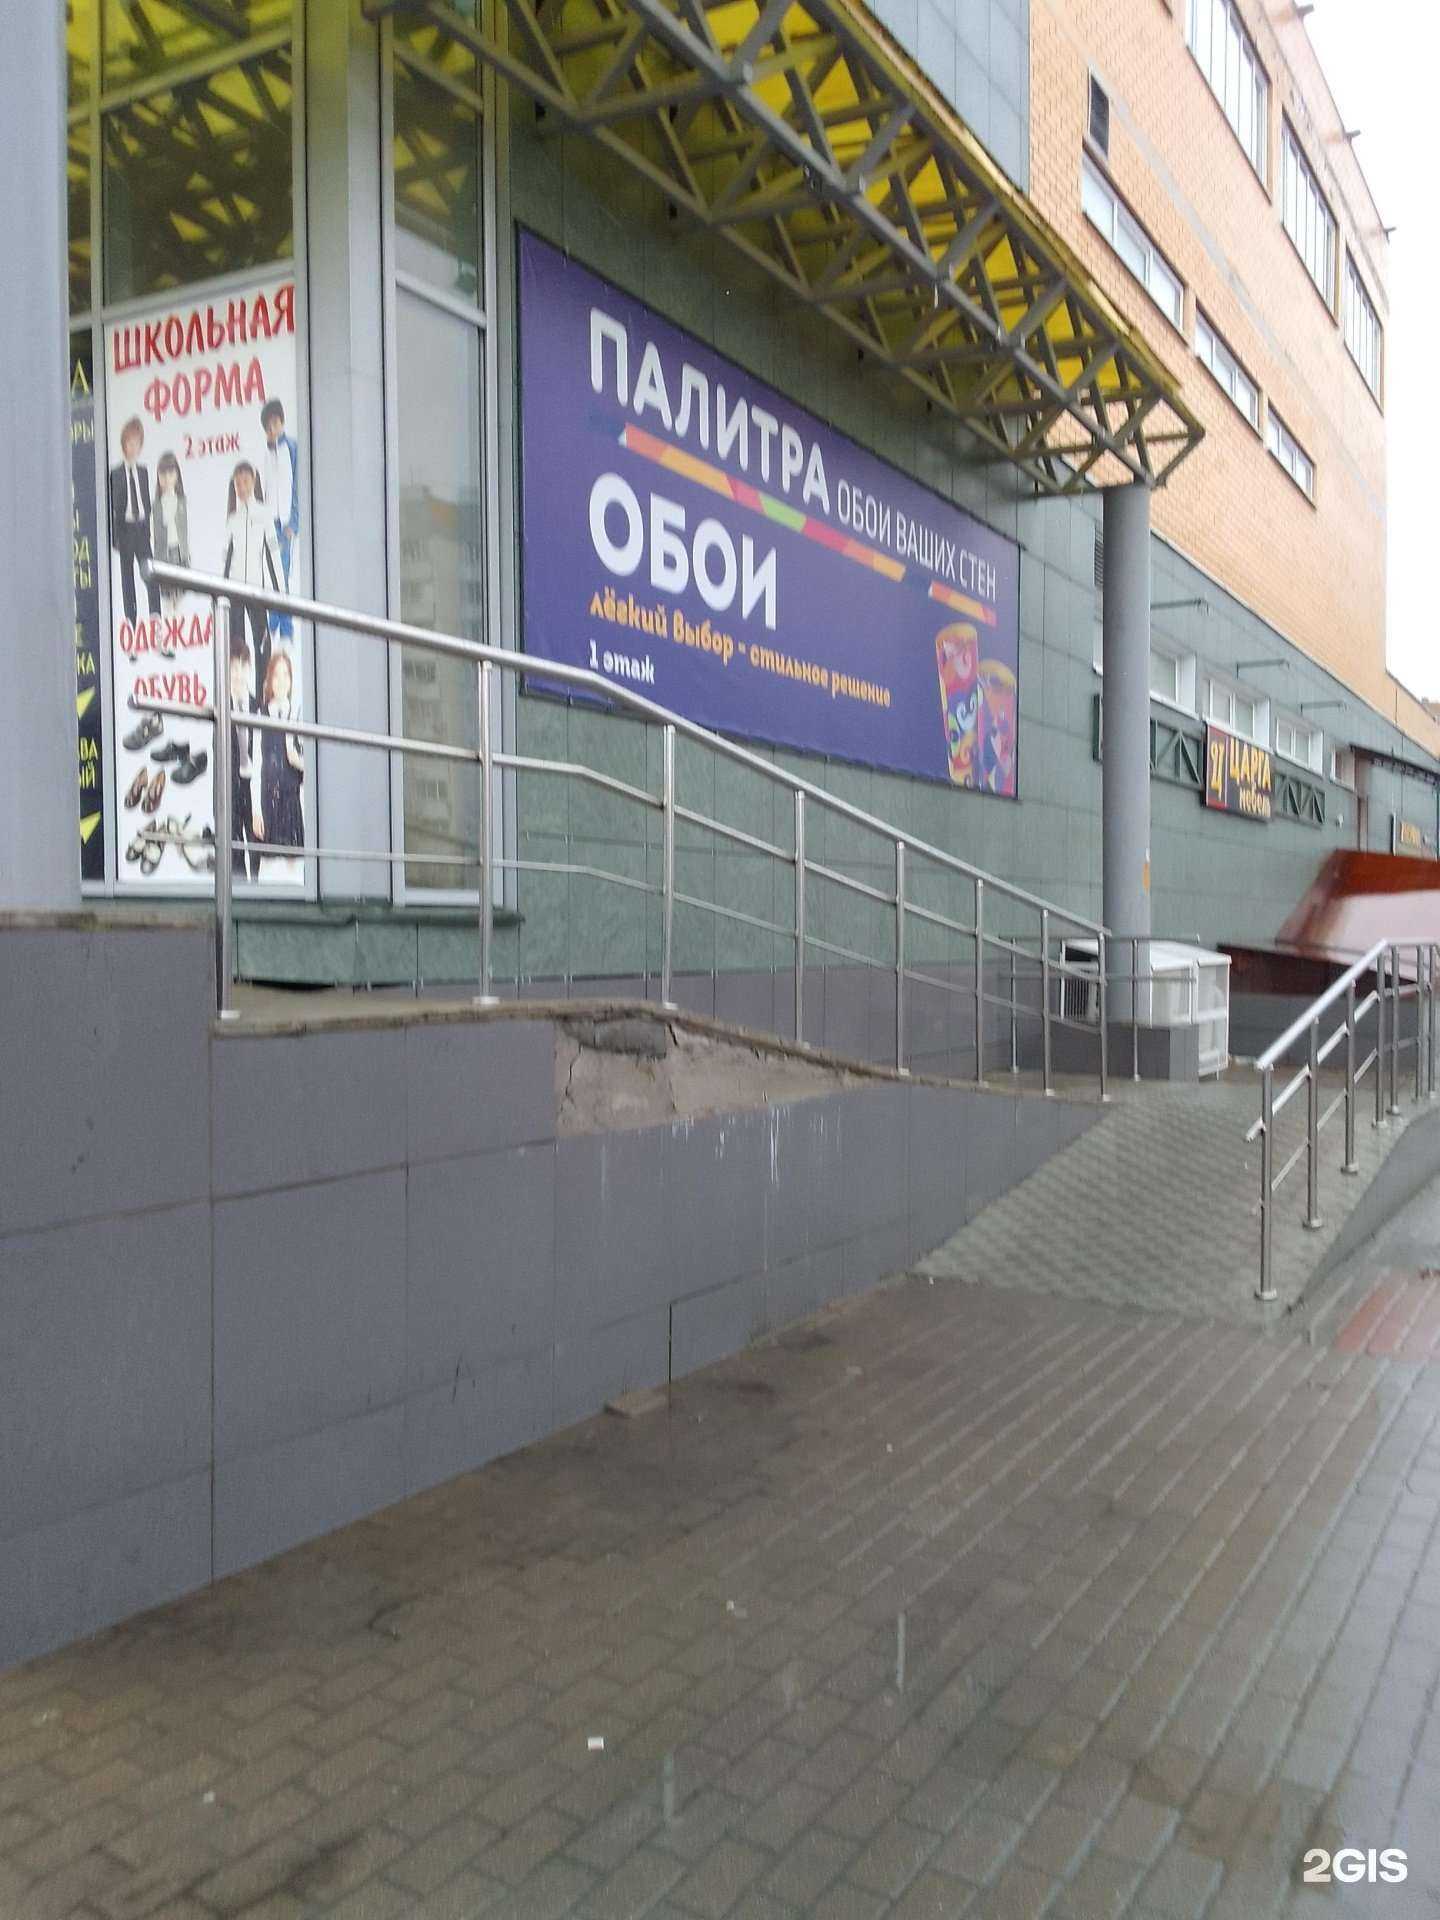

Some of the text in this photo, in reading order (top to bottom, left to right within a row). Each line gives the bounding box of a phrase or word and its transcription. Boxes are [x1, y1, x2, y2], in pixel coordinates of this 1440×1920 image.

[113, 283, 296, 374] ШКОЛЬНАЯ
[144, 356, 267, 422] ФОРМА
[184, 432, 240, 459] 2 этаж
[590, 307, 996, 604] ПАЛИТРА ОБОИ ВАШИХ СТЕН
[589, 472, 777, 631] ОБОИ
[133, 671, 207, 707] ОБУВЬ
[589, 638, 656, 685] 1 этаж
[750, 643, 829, 689] стильное
[831, 670, 891, 708] решение
